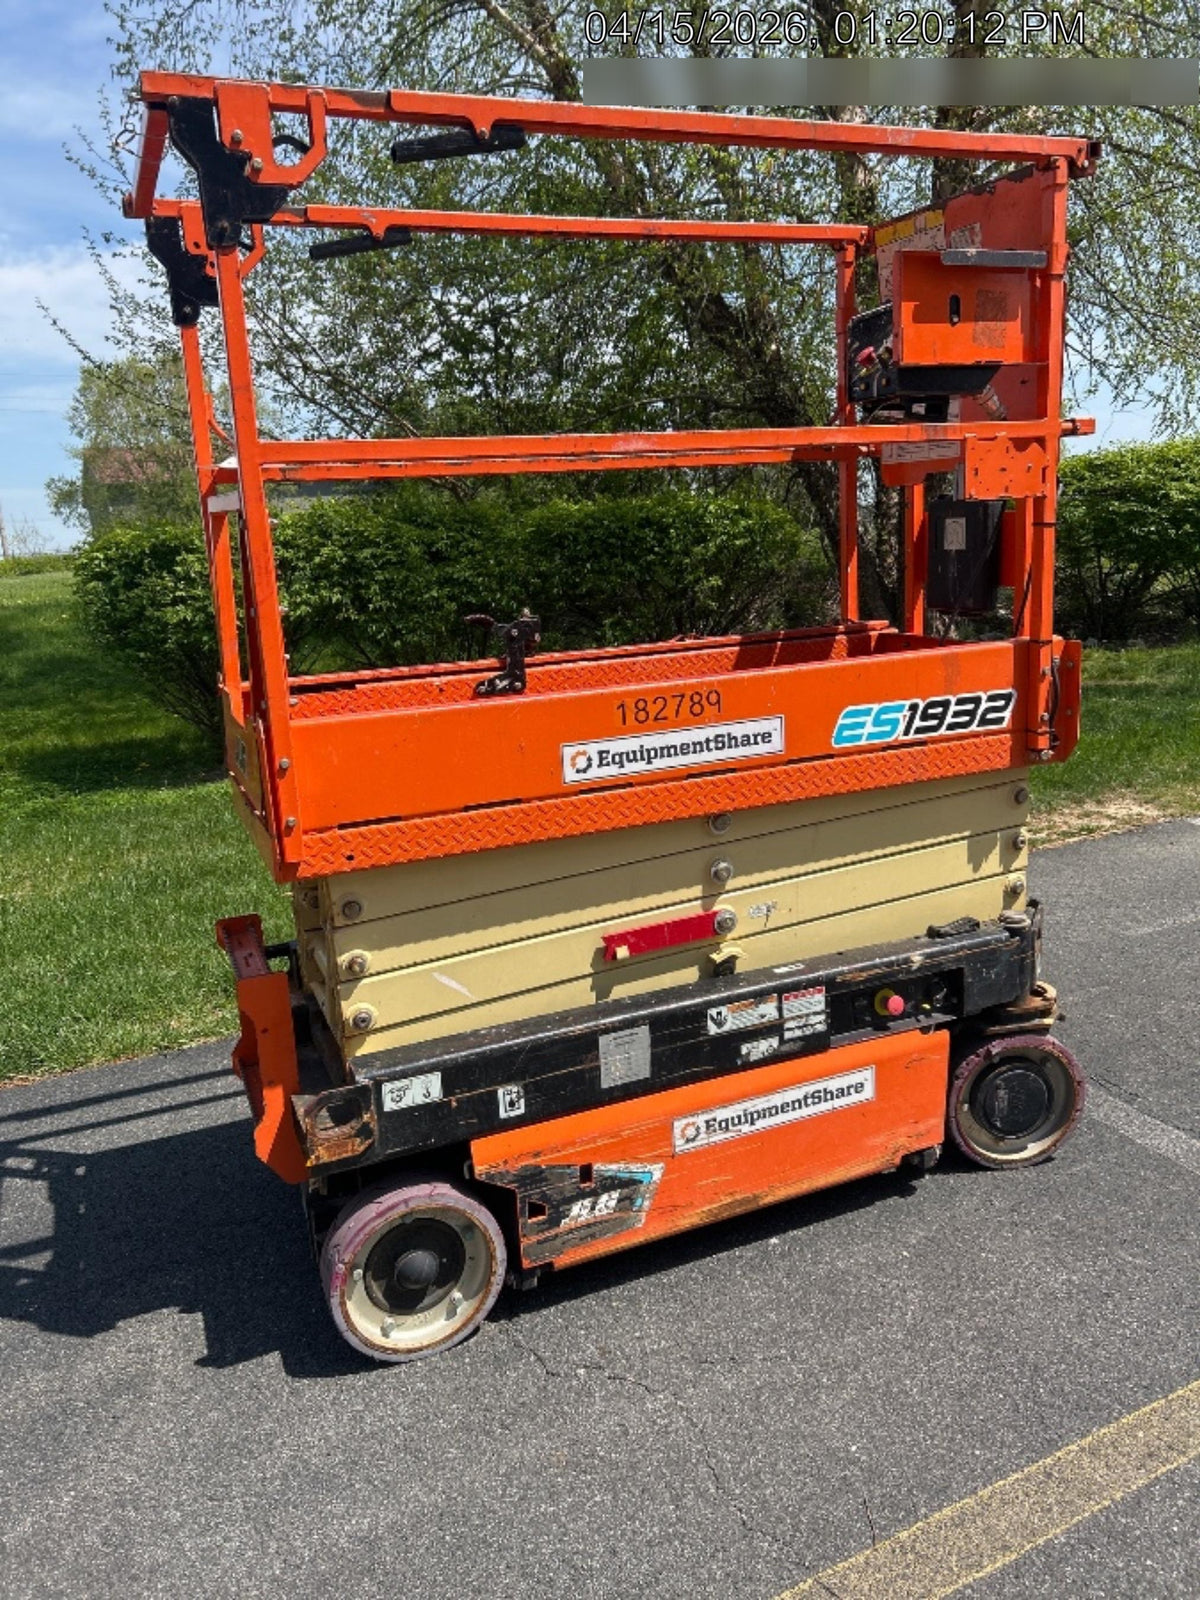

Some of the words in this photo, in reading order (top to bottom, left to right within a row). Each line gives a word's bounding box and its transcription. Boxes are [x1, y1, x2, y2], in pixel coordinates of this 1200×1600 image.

[616, 690, 722, 726] 182789
[832, 690, 1015, 747] ES1932
[597, 730, 772, 769] EquipmentShare
[704, 1081, 866, 1135] EquipmentShare
